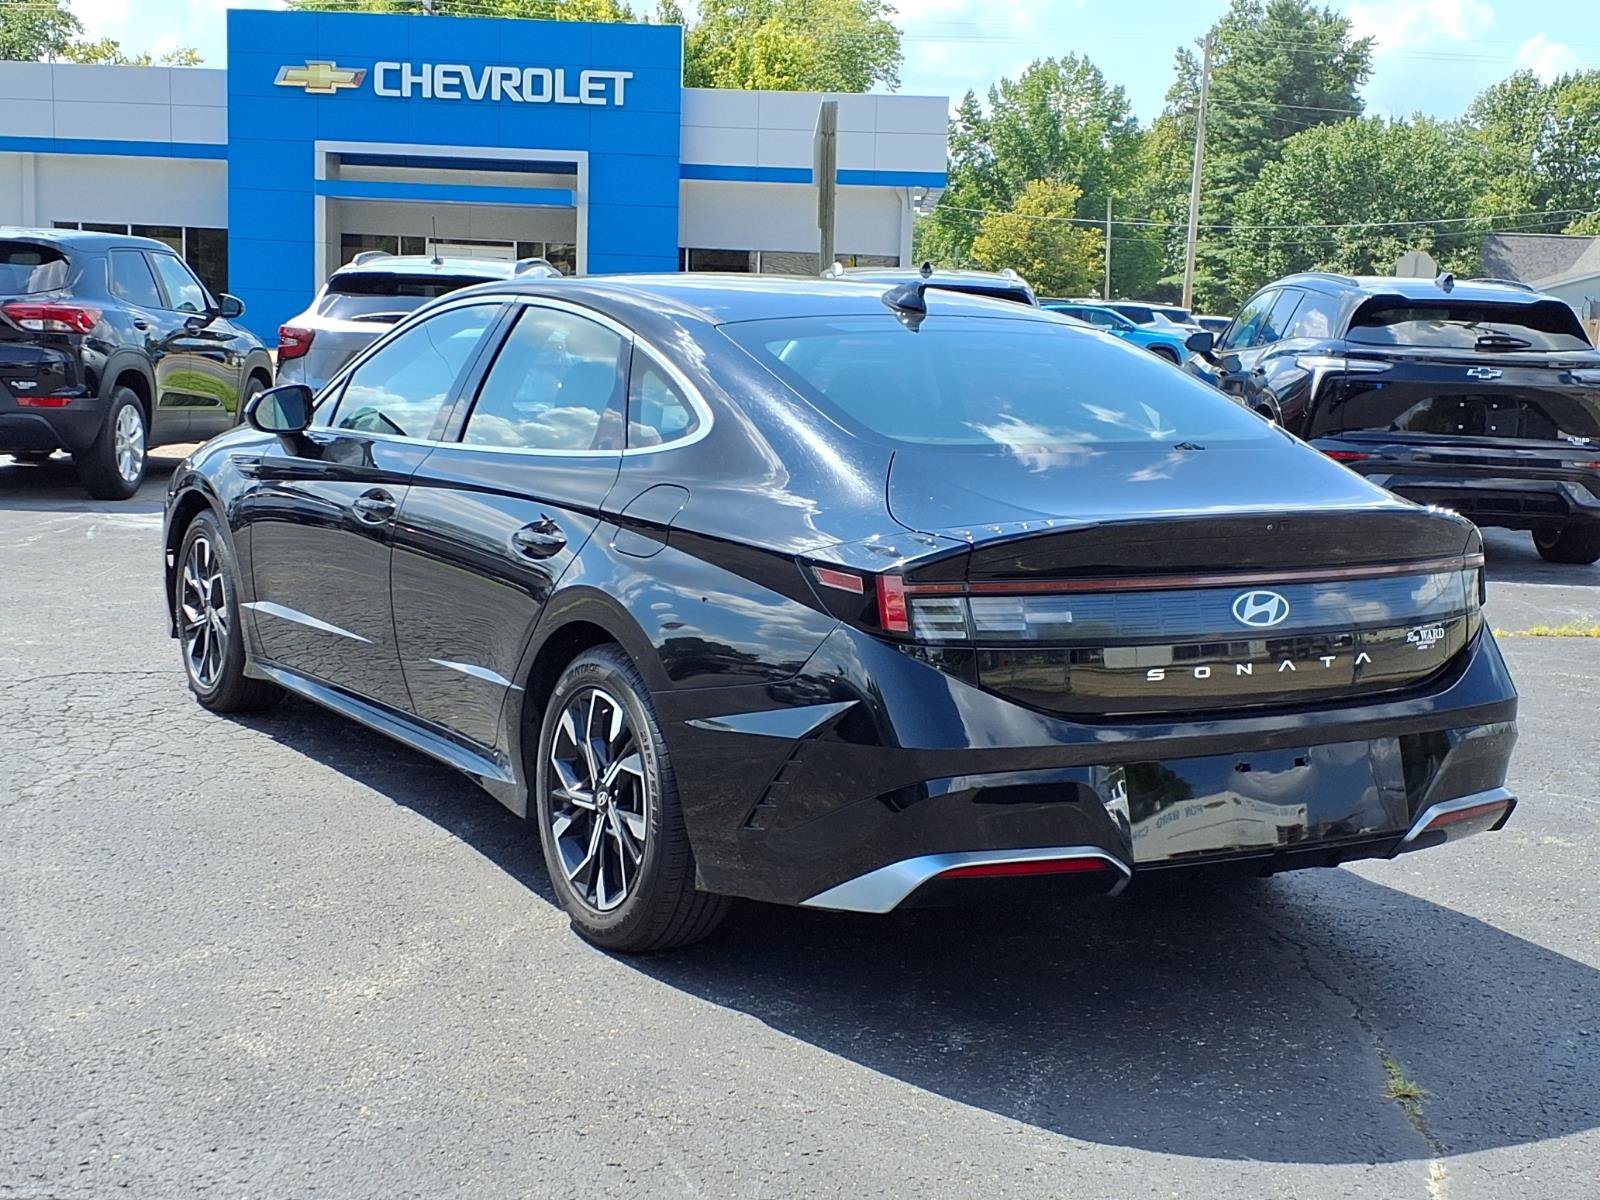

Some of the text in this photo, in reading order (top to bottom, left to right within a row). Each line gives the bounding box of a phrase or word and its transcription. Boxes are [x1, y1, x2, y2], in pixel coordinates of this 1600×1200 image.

[373, 61, 634, 107] CHEVROLET
[1420, 627, 1445, 640] WARD
[1146, 652, 1372, 681] SONATA
